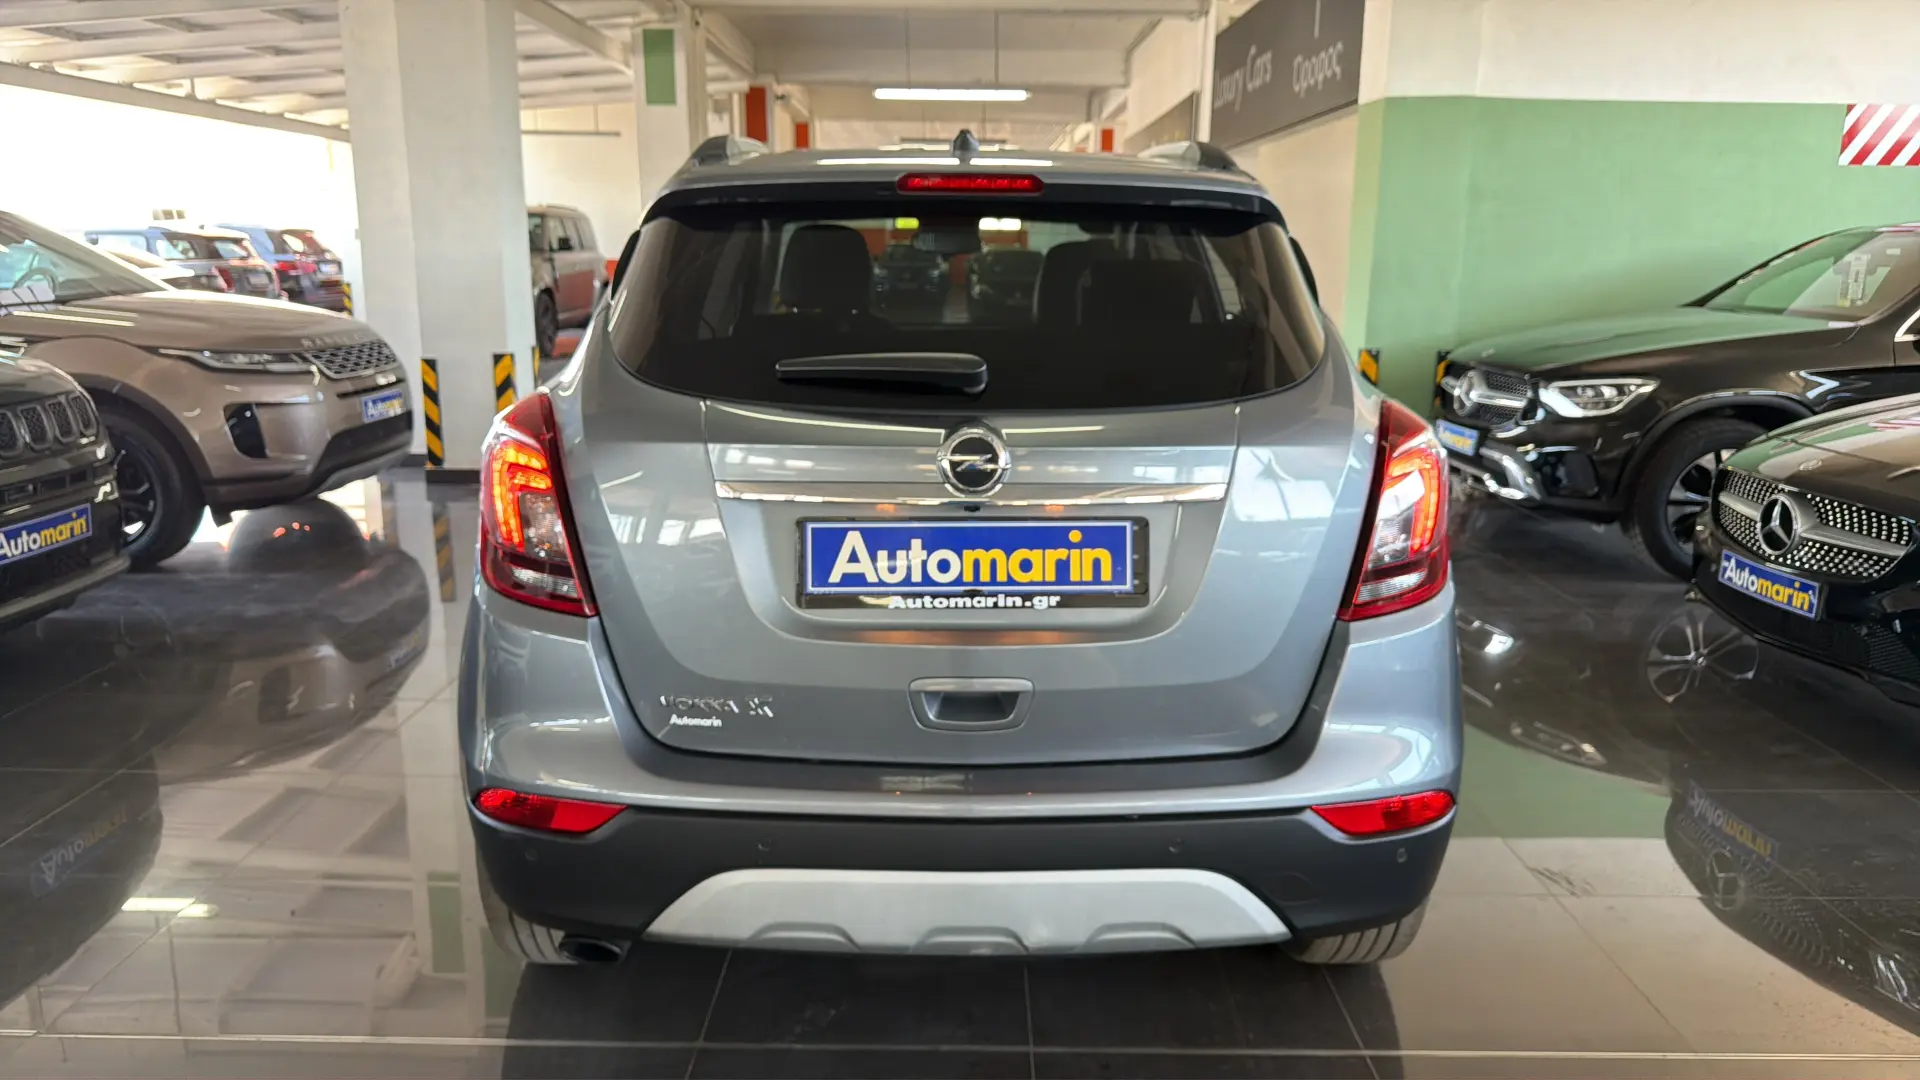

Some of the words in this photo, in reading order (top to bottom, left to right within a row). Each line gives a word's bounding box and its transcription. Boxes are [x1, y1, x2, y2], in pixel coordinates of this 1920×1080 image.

[1246, 44, 1273, 92] Cars
[828, 529, 1113, 584] Automarin
[888, 594, 1061, 612] Automarin.gr
[1724, 556, 1810, 612] Automarin
[668, 713, 722, 728] Automarin
